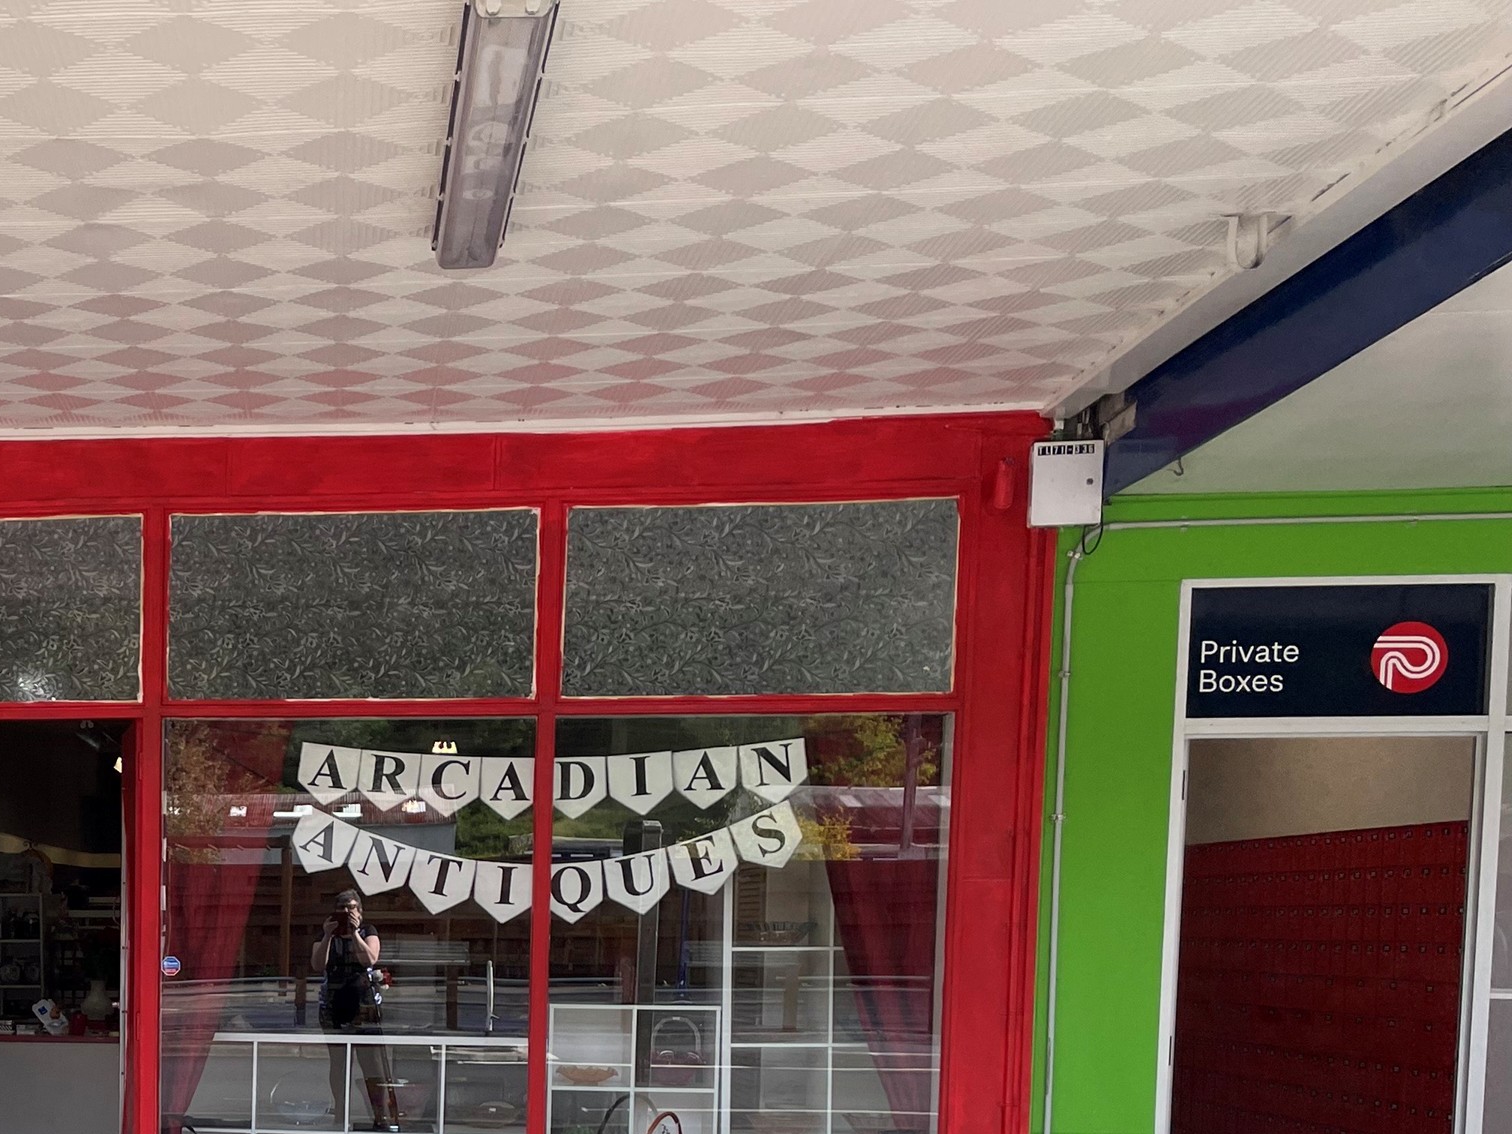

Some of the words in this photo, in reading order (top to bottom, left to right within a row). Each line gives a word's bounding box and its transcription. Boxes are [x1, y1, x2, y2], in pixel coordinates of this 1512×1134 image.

[1200, 640, 1300, 663] Private
[1199, 669, 1284, 693] Boxes
[307, 742, 794, 802] ARCADIAN
[299, 811, 787, 913] ANTIQUES
